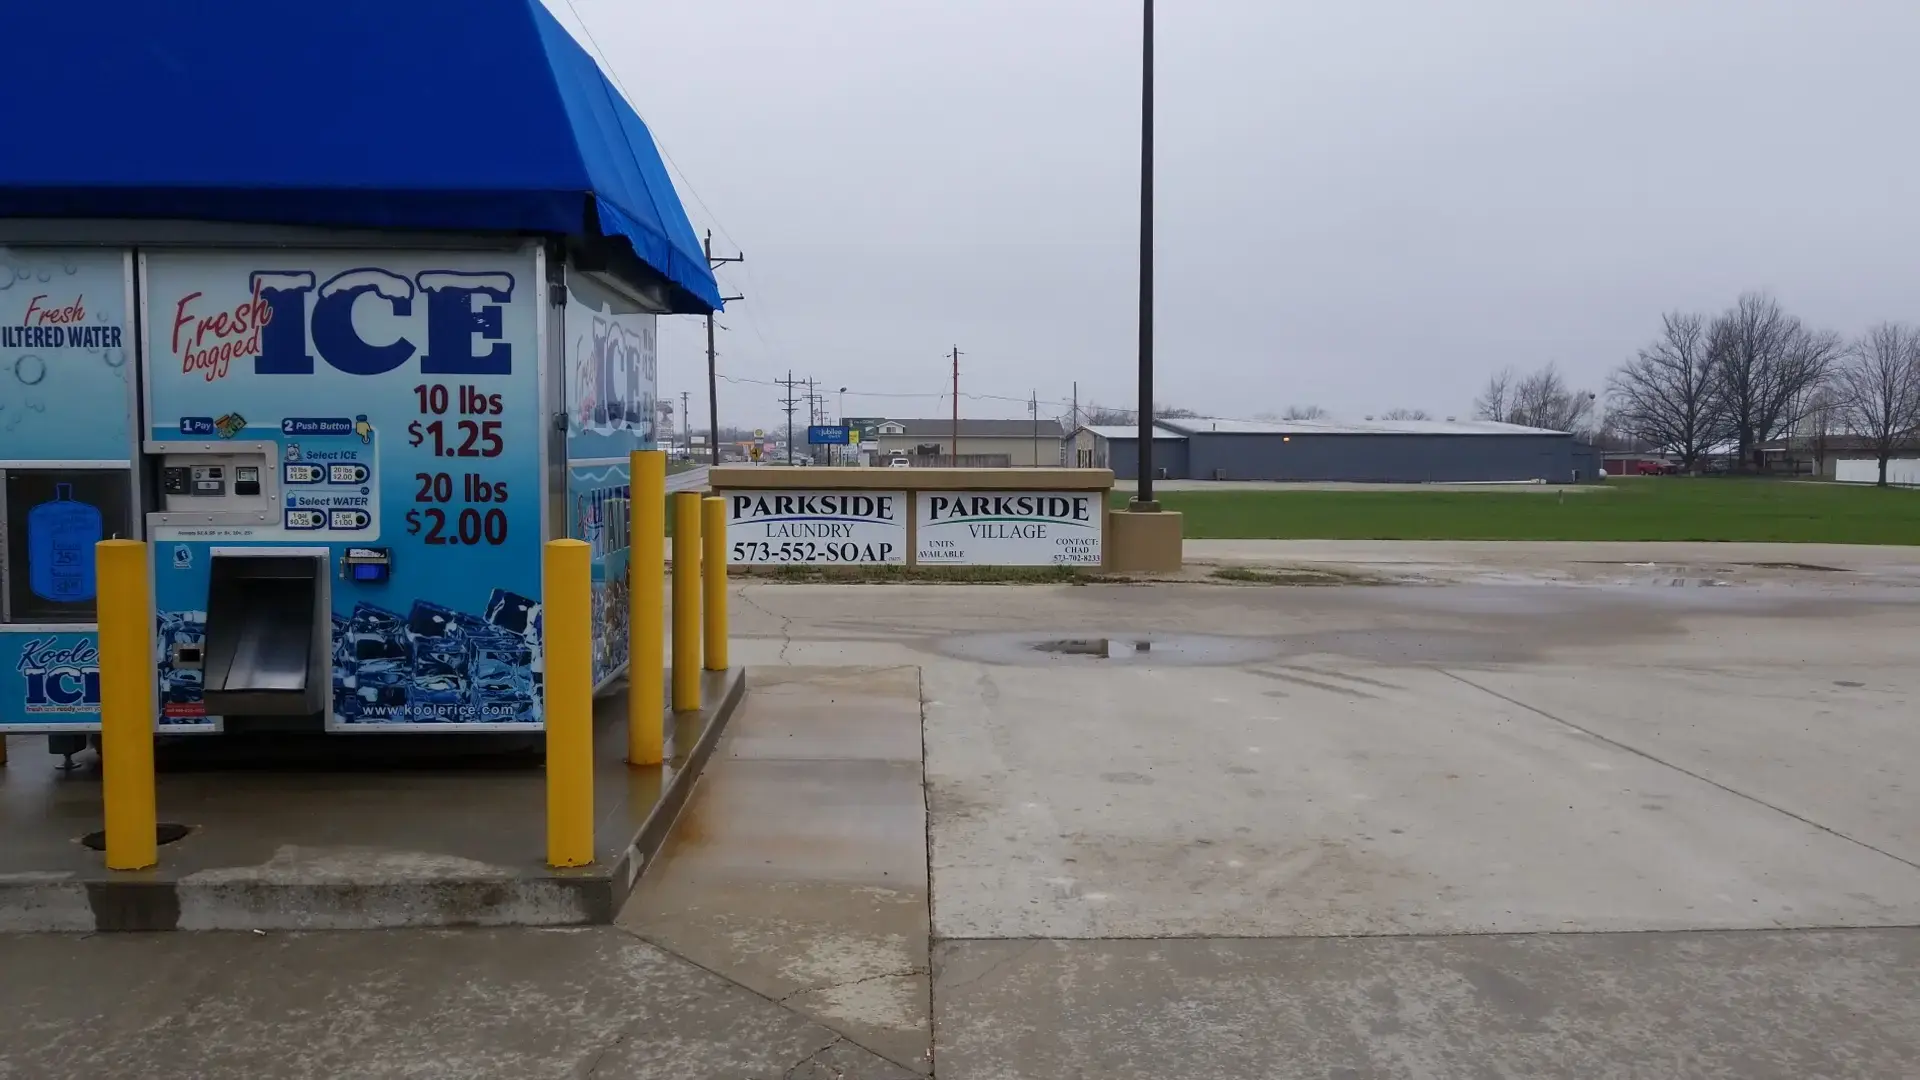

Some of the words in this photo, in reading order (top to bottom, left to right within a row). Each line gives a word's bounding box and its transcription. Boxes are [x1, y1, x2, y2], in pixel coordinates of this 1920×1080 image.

[24, 293, 85, 326] Fresh
[172, 278, 272, 353] Fresh
[249, 267, 515, 375] ICE
[2, 326, 65, 348] ILTERED
[67, 326, 122, 348] WATER
[183, 326, 260, 381] bagged
[413, 384, 449, 415] 10
[459, 385, 504, 415] lbs
[183, 420, 193, 431] 1
[194, 421, 212, 431] Pay
[284, 420, 294, 431] 2
[296, 422, 318, 430] Push
[320, 422, 350, 430] Button
[408, 420, 504, 457] $1.25
[306, 451, 338, 460] Select
[340, 451, 358, 460] ICE
[415, 472, 453, 503] 20
[464, 473, 508, 503] lbs
[298, 497, 330, 505] Select
[333, 497, 369, 505] WATER
[732, 495, 894, 521] PARKSIDE
[929, 496, 1089, 521] PARKSIDE
[405, 508, 508, 545] $2.00
[766, 523, 855, 538] LAUNDRY
[968, 524, 1047, 539] VILLAGE
[733, 541, 893, 561] 573-552-SOAP
[929, 540, 954, 548] UNITS
[1055, 538, 1099, 546] CONTACT:
[1065, 546, 1089, 554] CHAD
[918, 550, 965, 558] AVAILABLE
[1053, 554, 1100, 562] 573-702-8233
[16, 636, 99, 671] Koole
[362, 703, 514, 715] www.koolerice.com
